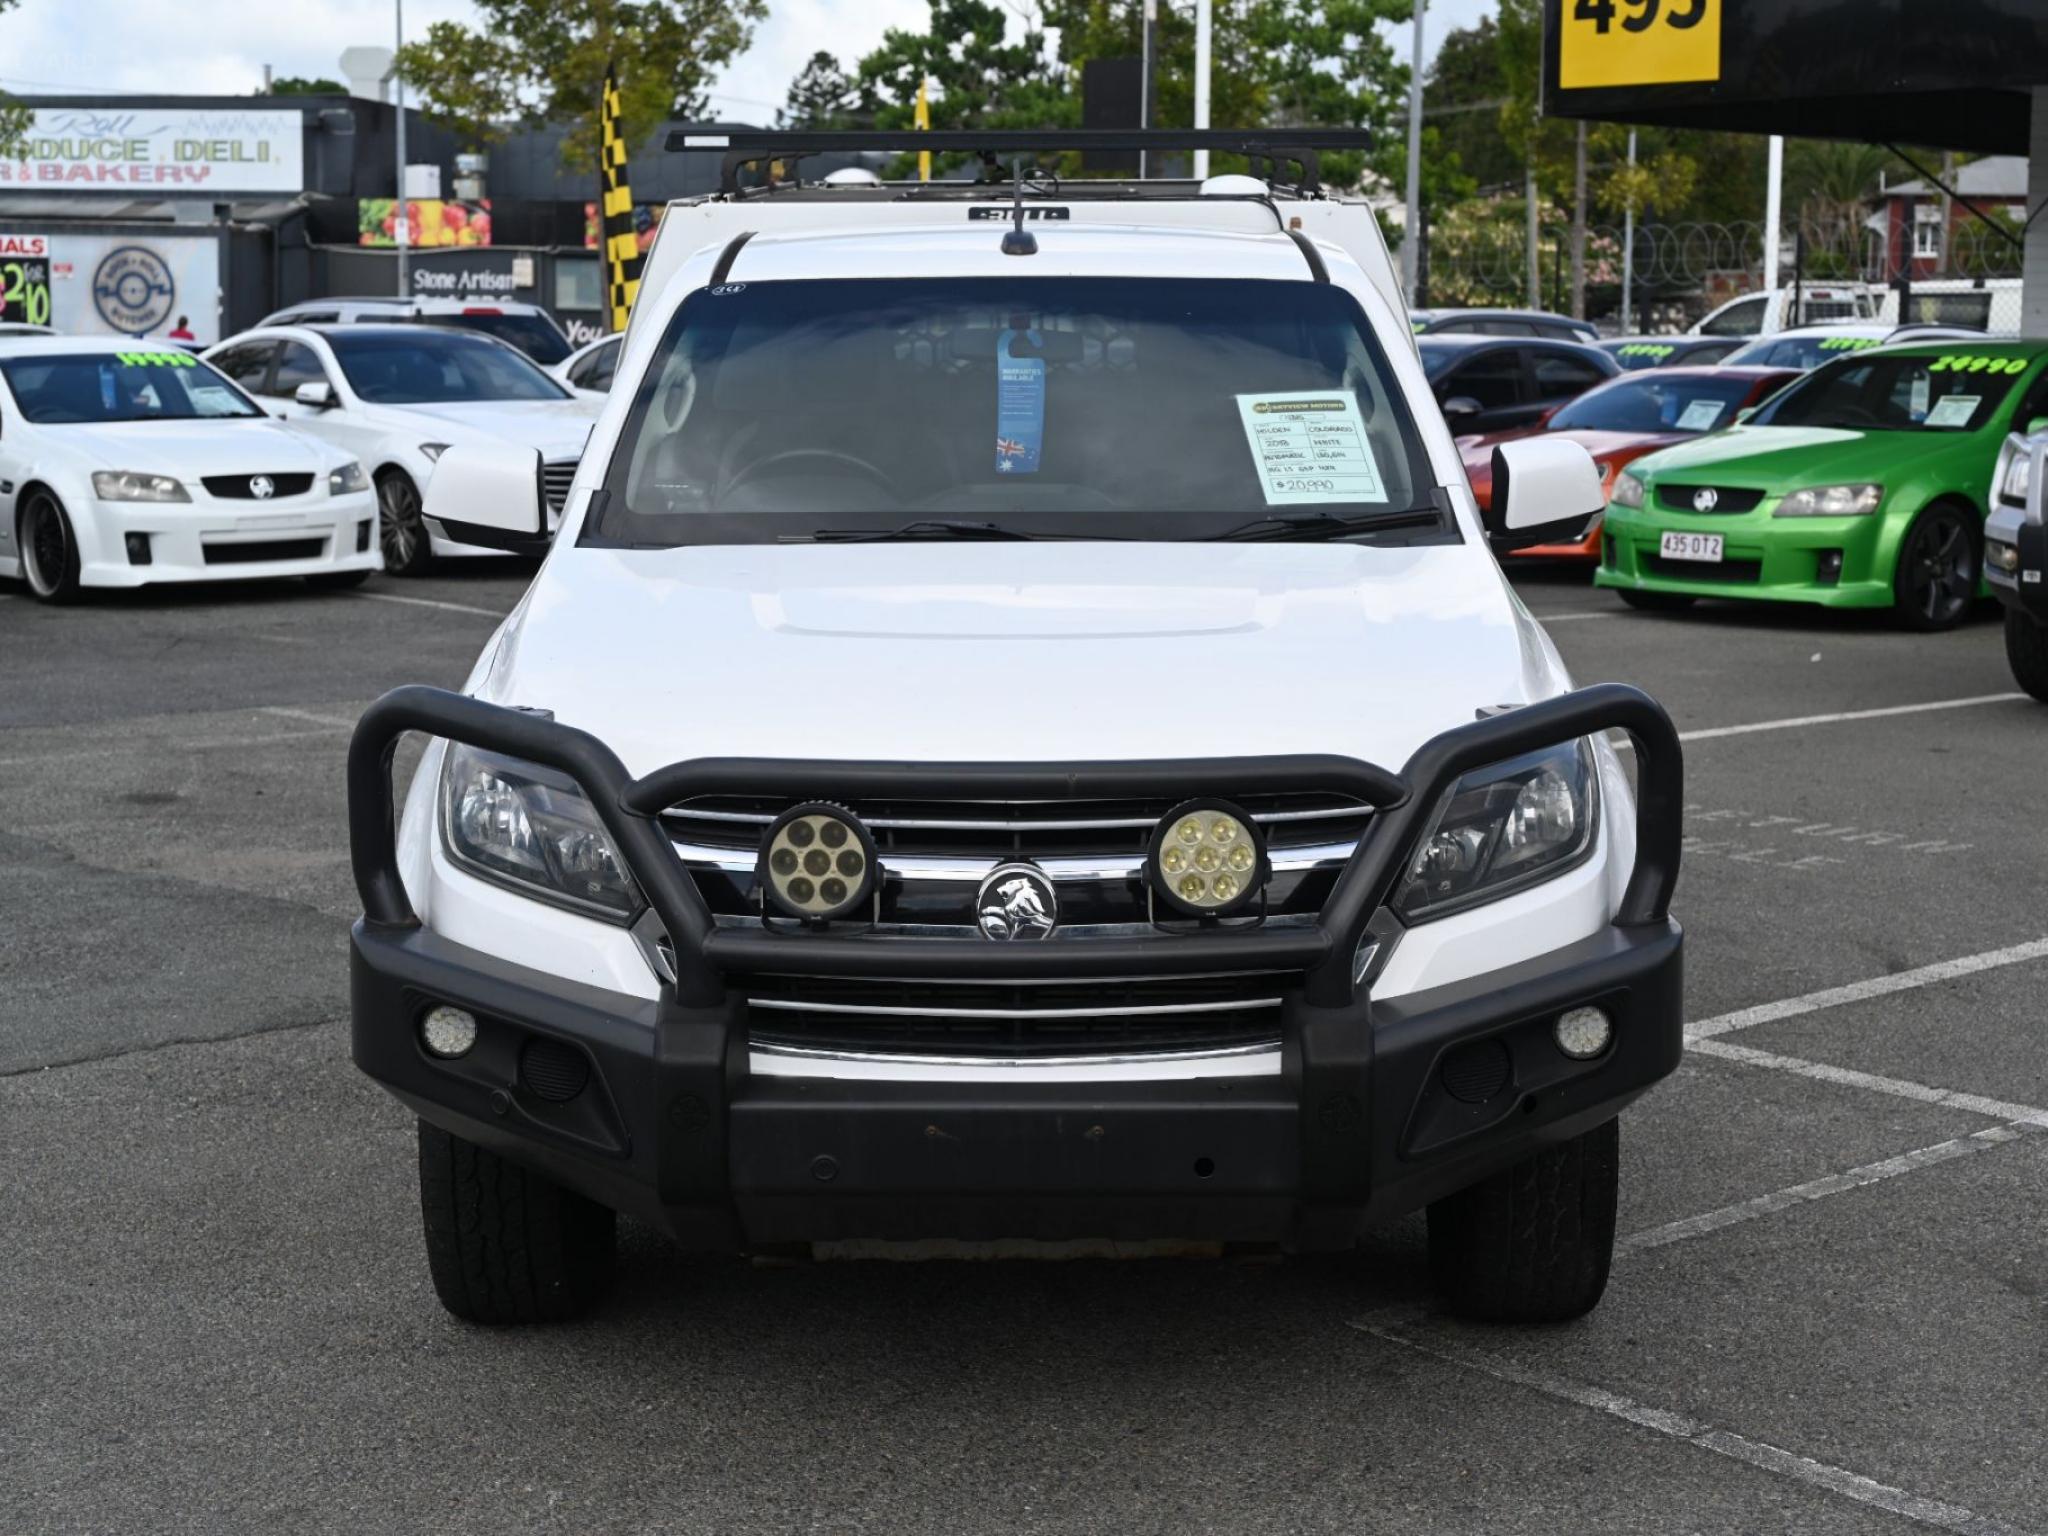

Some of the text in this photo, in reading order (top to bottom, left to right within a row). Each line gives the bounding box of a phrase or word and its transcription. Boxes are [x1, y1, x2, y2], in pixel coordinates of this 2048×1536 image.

[37, 163, 211, 183] BAKERY
[414, 269, 457, 289] Stone
[1664, 535, 1687, 553] 435
